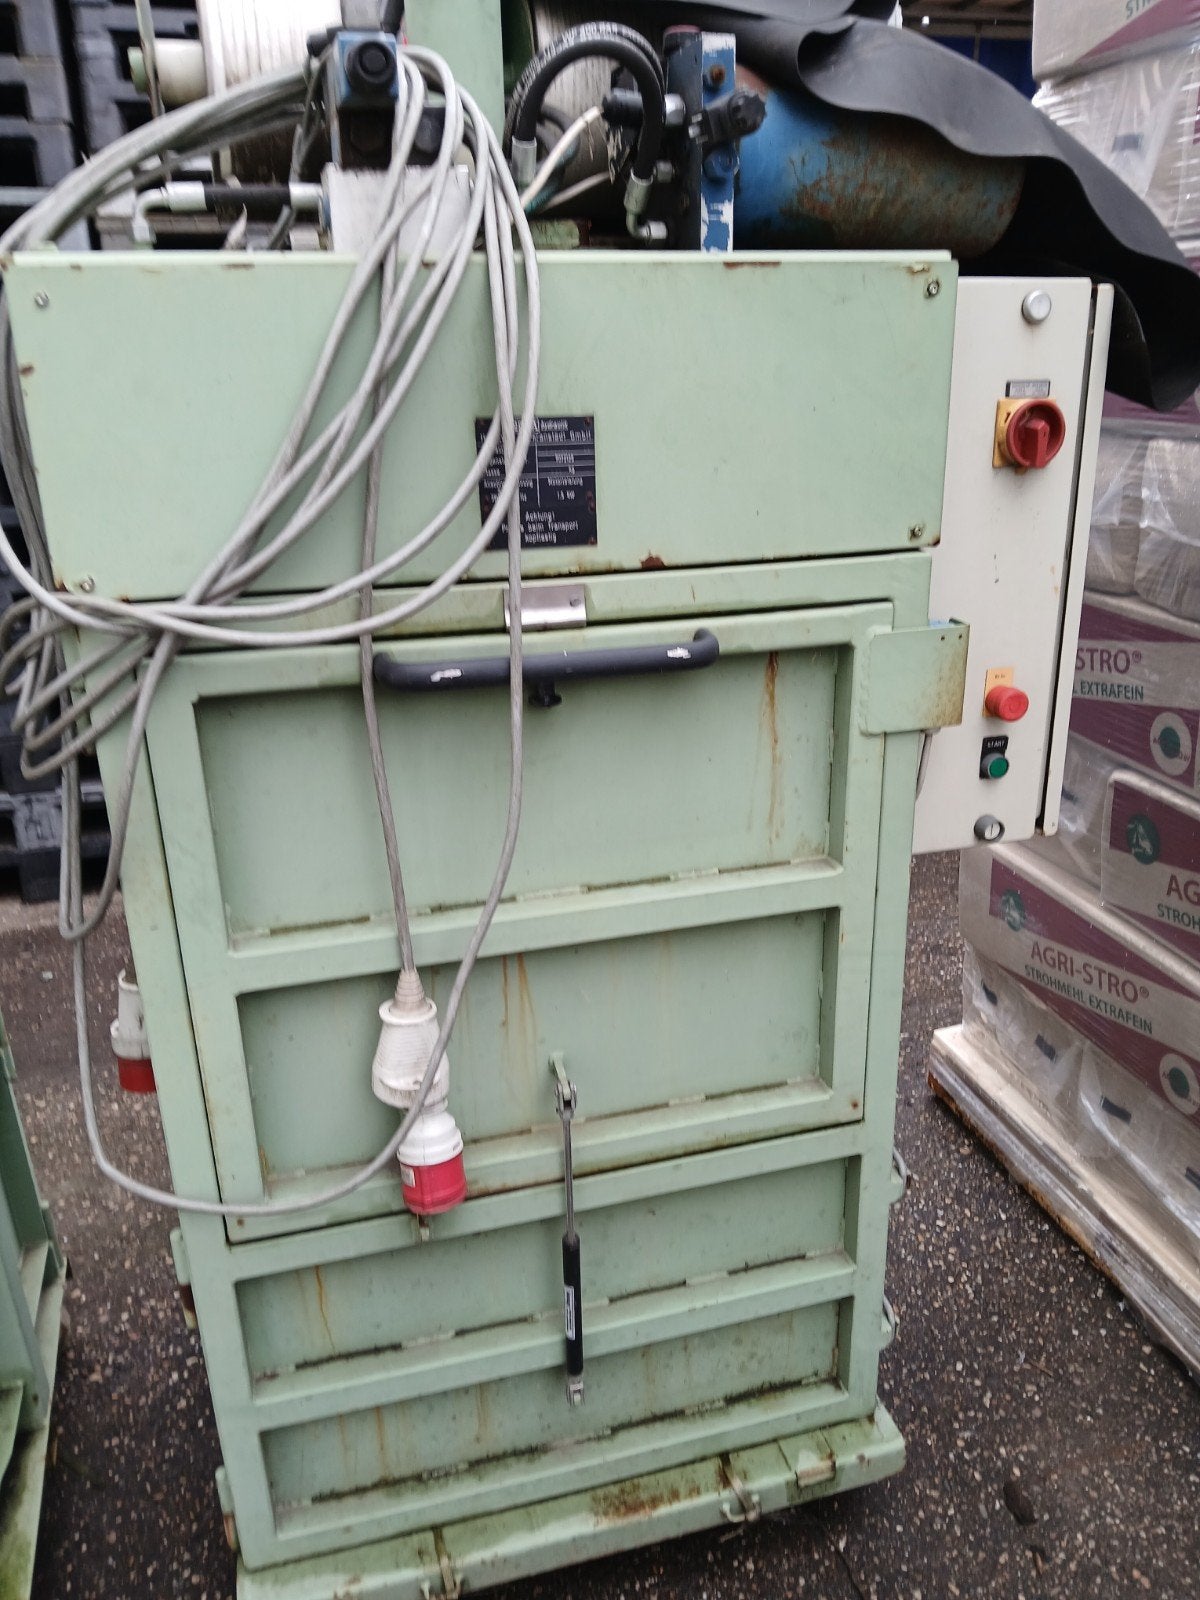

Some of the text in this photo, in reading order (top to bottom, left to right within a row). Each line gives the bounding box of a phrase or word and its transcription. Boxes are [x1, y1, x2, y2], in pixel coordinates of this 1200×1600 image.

[547, 520, 579, 533] Transport
[1080, 680, 1145, 701] EXTRAFEIN
[987, 740, 1006, 748] START
[1024, 963, 1153, 1035] STROHMEHL EXTRAFEIN
